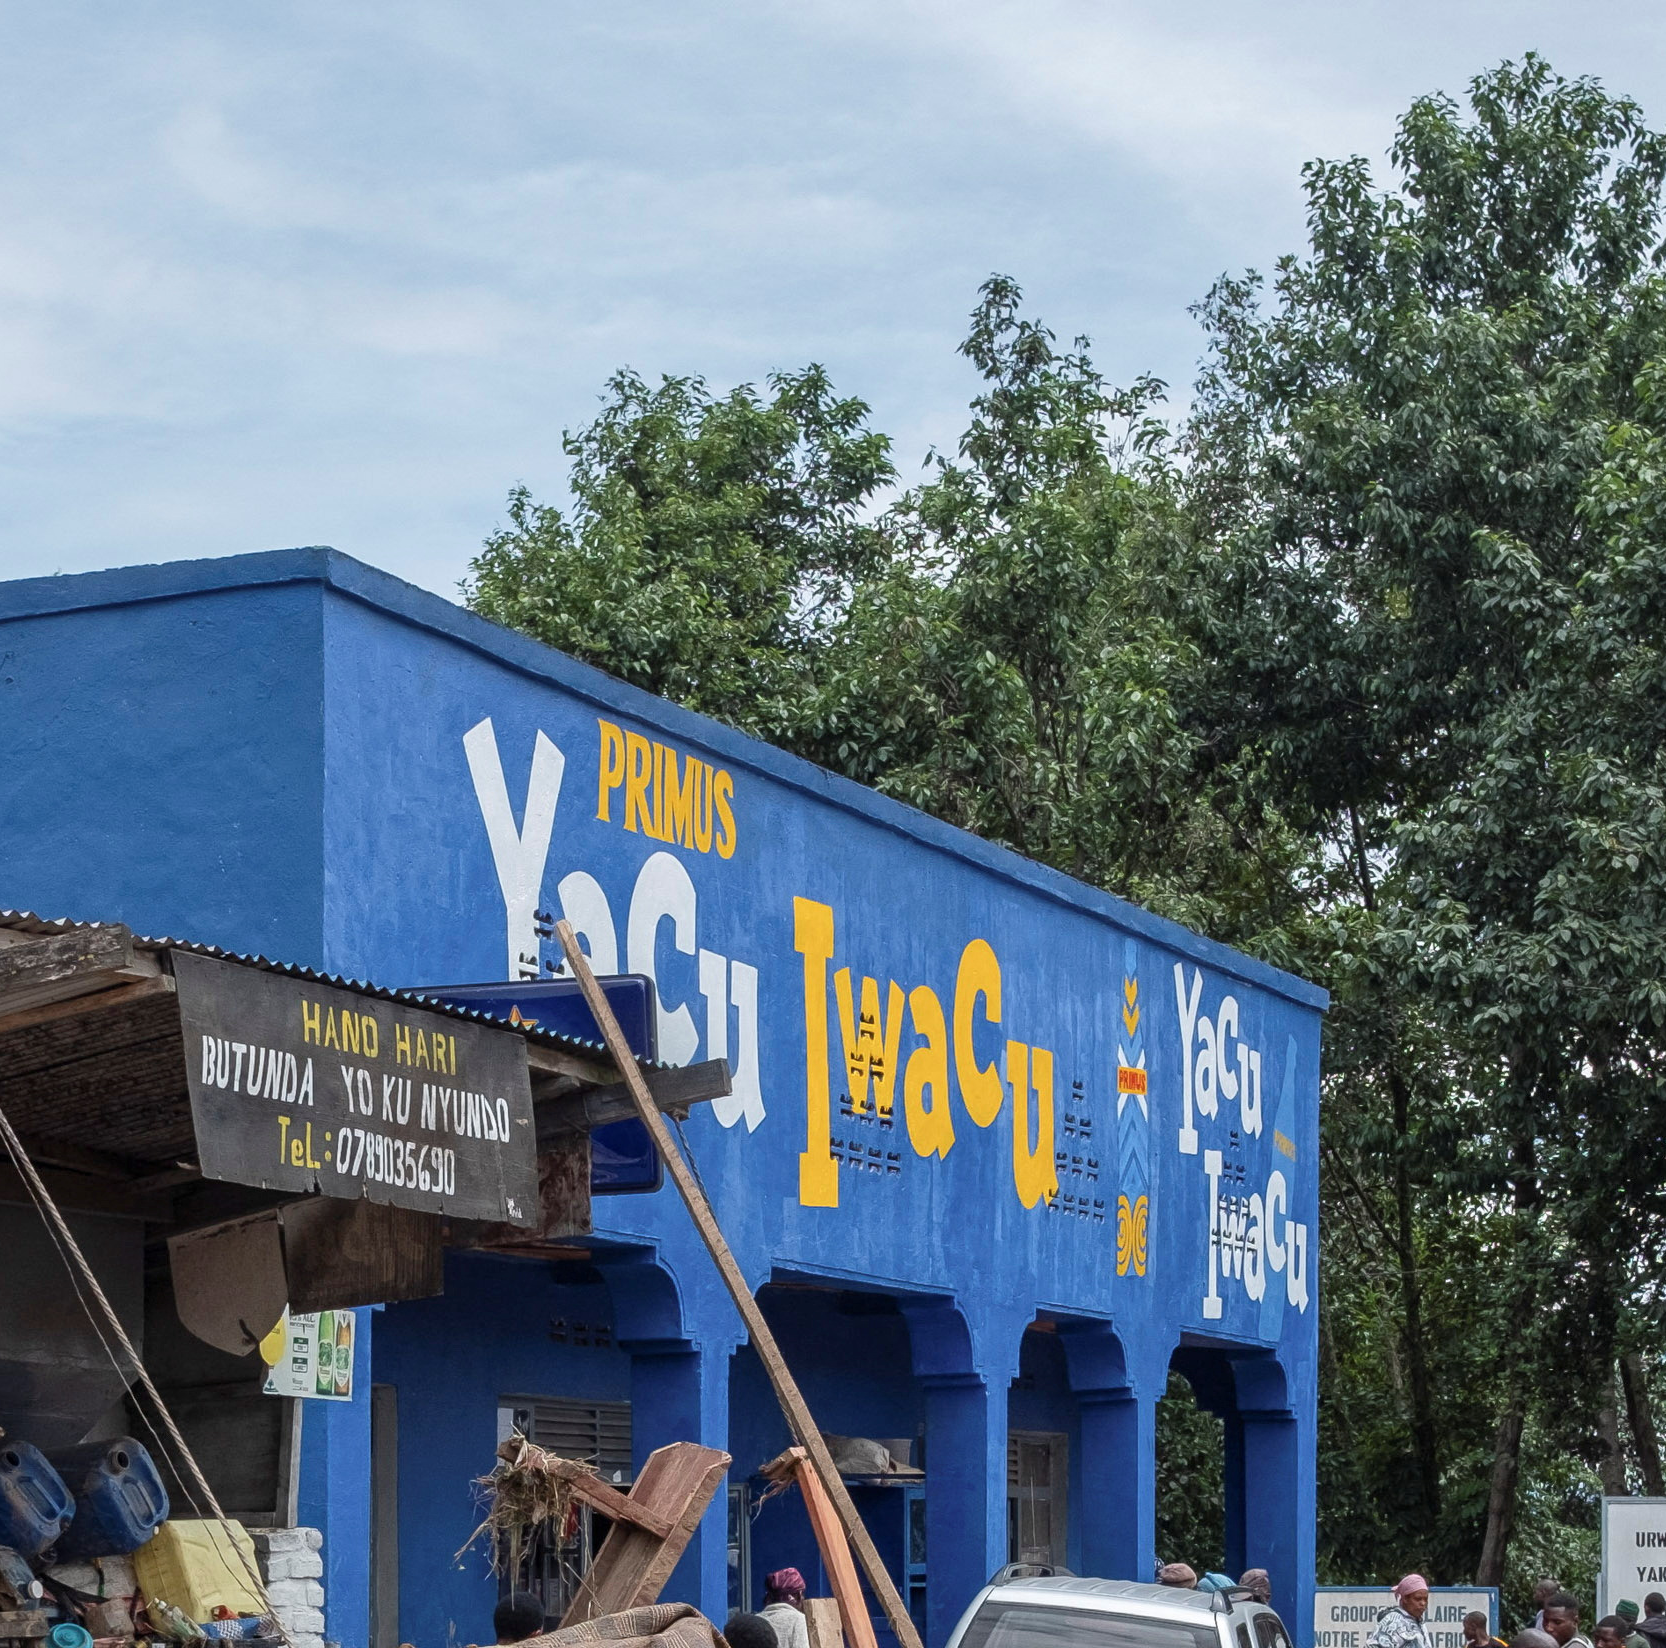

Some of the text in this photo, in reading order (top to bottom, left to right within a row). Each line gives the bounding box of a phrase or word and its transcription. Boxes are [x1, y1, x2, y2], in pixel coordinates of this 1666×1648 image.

[597, 718, 737, 860] PRIMUS
[301, 999, 457, 1075] HANO HARI
[201, 1035, 511, 1143] BUTUNDA YO KU NYUNDO
[1119, 1069, 1146, 1093] PRIMUS
[336, 1127, 456, 1196] 0789035690
[1314, 1631, 1359, 1648] NOTRE
[1331, 1605, 1384, 1622] GROUP
